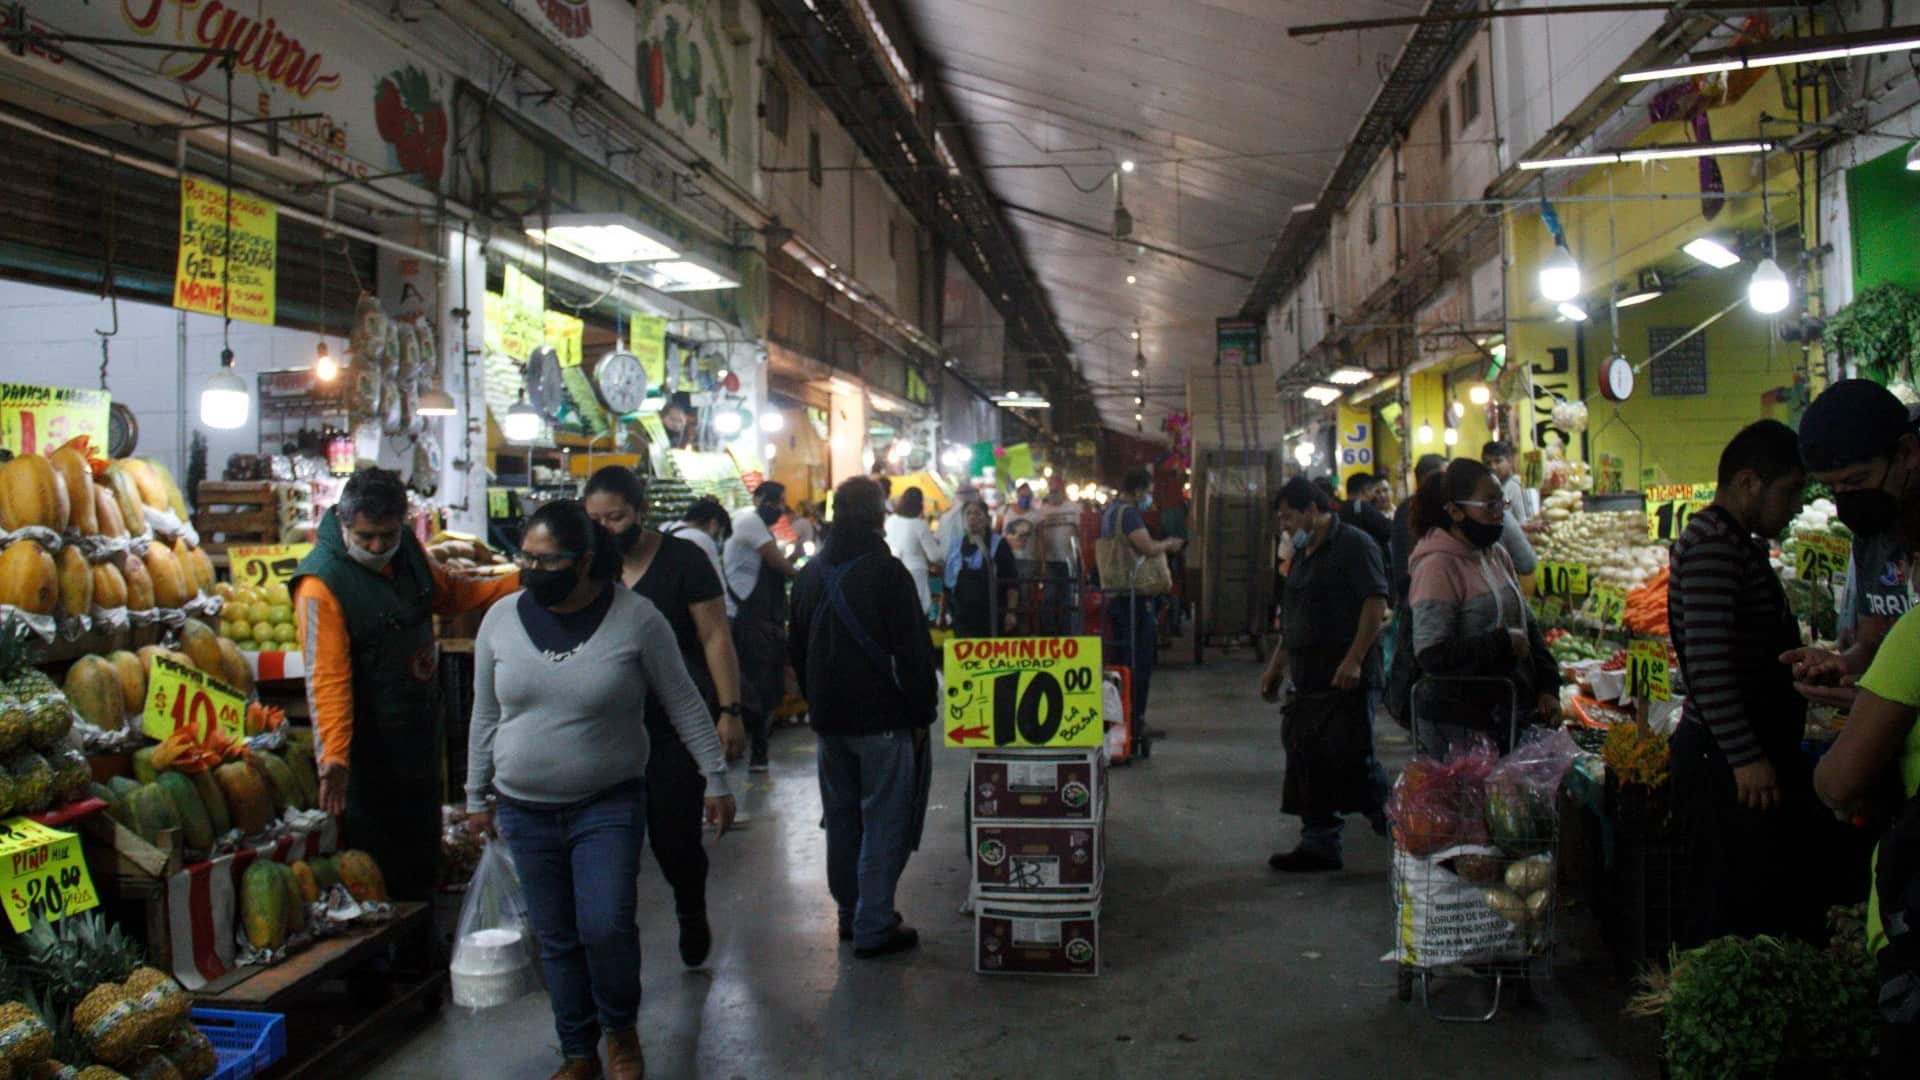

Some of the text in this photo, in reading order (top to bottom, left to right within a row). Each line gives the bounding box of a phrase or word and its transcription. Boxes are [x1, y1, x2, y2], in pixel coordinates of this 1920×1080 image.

[1346, 424, 1367, 442] J
[1343, 447, 1371, 466] 60
[989, 658, 1056, 670] CALIDAD
[171, 683, 217, 746] 10
[994, 667, 1092, 746] 10 00
[1064, 705, 1080, 723] LA
[12, 844, 49, 875] PIÑA
[26, 875, 63, 919] 20
